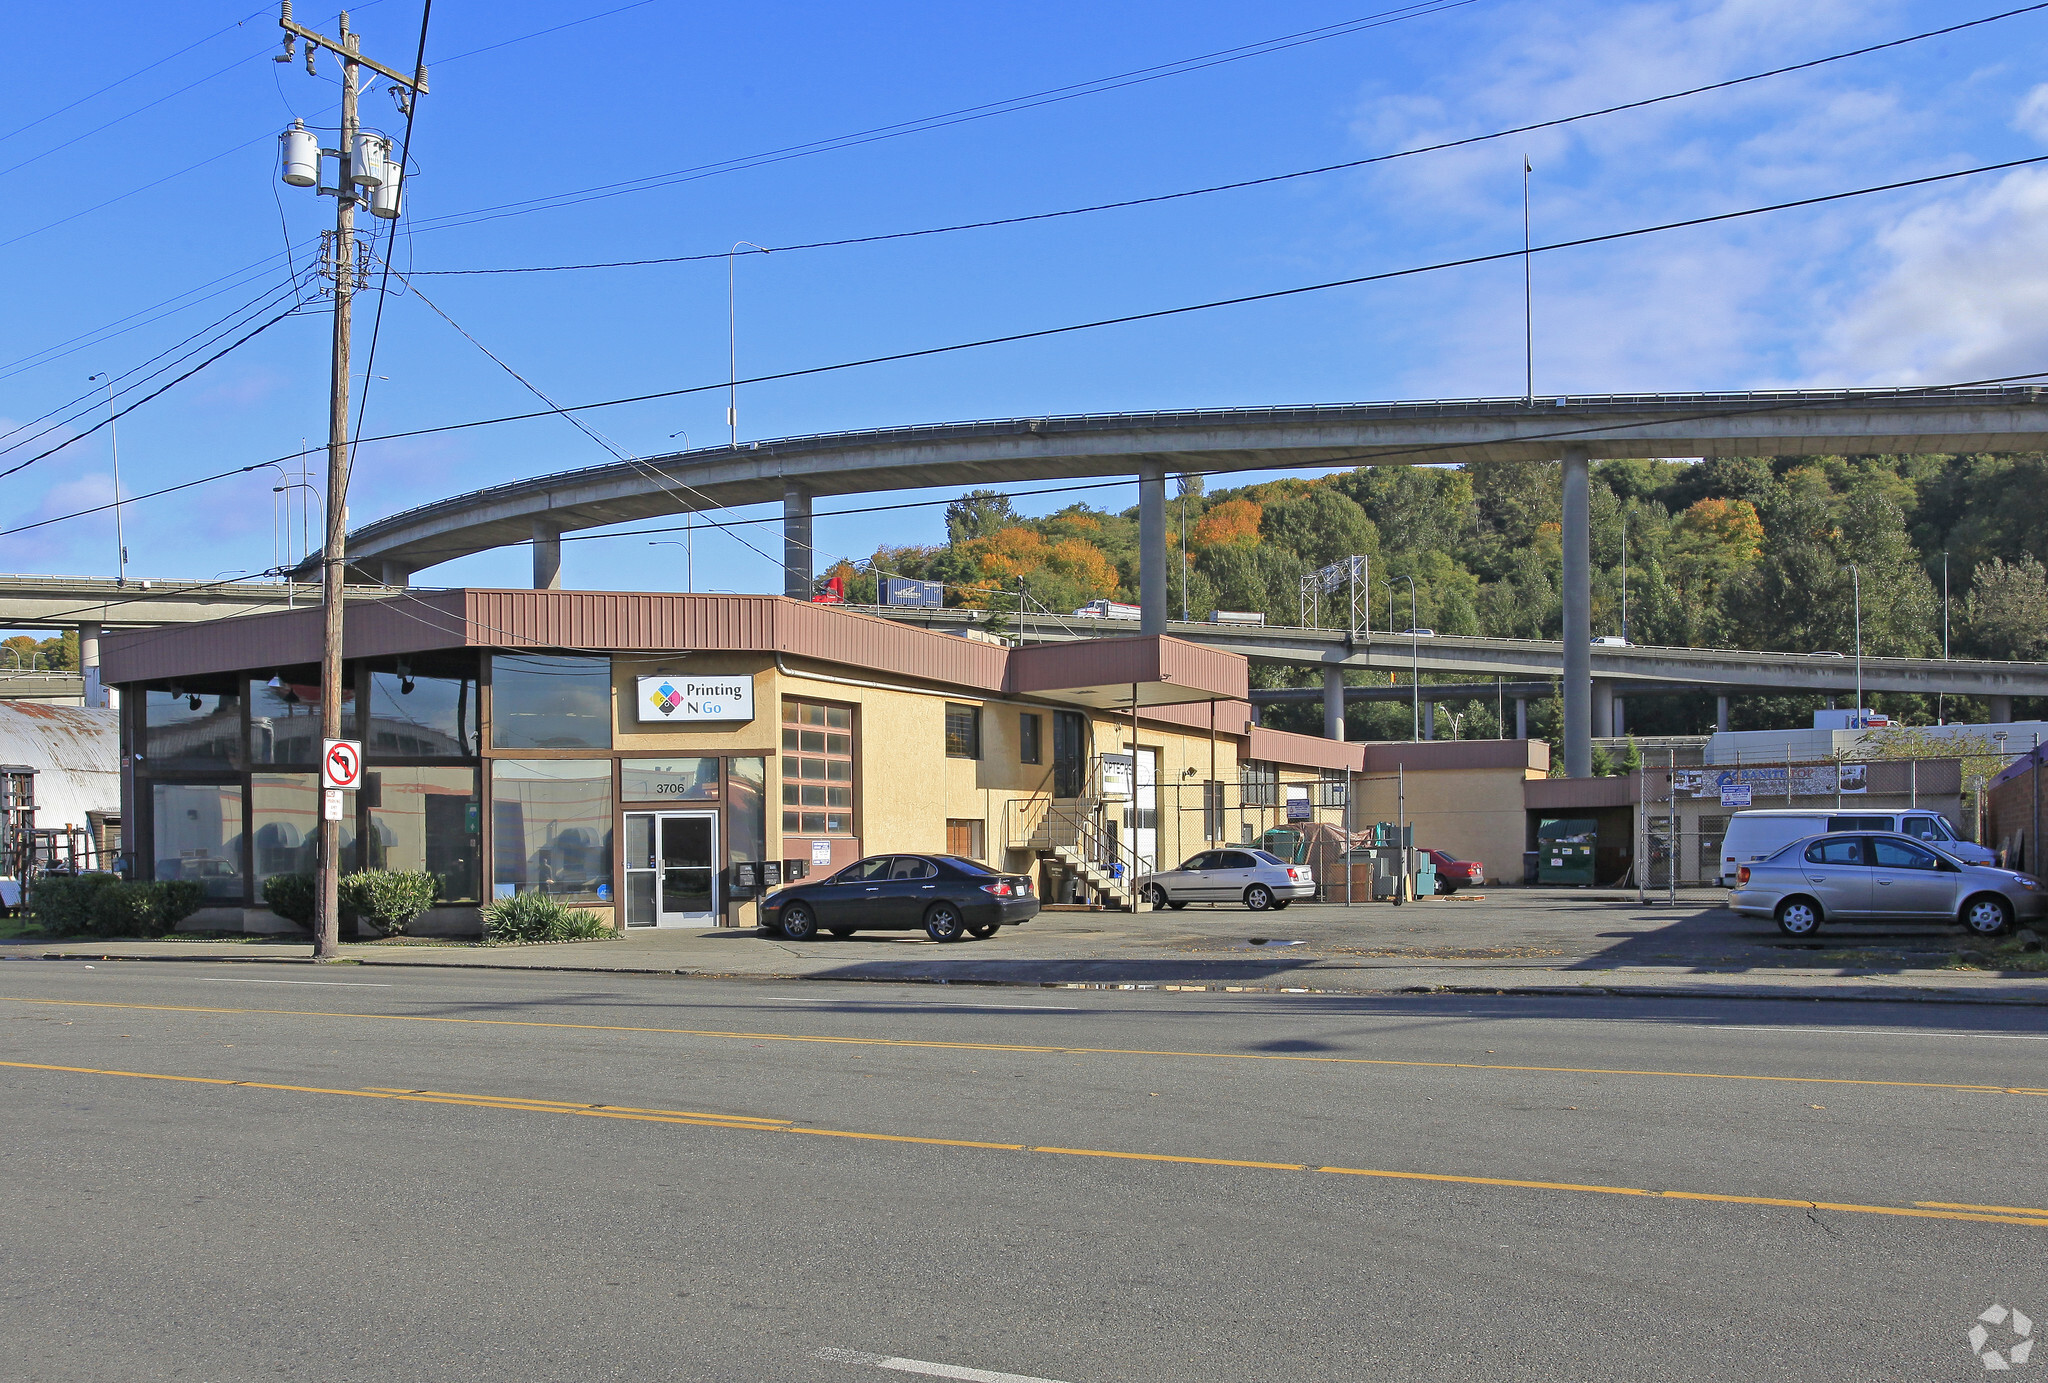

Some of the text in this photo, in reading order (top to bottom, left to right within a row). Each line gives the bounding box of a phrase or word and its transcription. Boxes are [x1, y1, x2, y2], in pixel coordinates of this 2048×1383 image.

[687, 683, 742, 700] Printing
[687, 701, 722, 714] N Go
[1789, 768, 1814, 778] TOP
[656, 783, 685, 794] 3706
